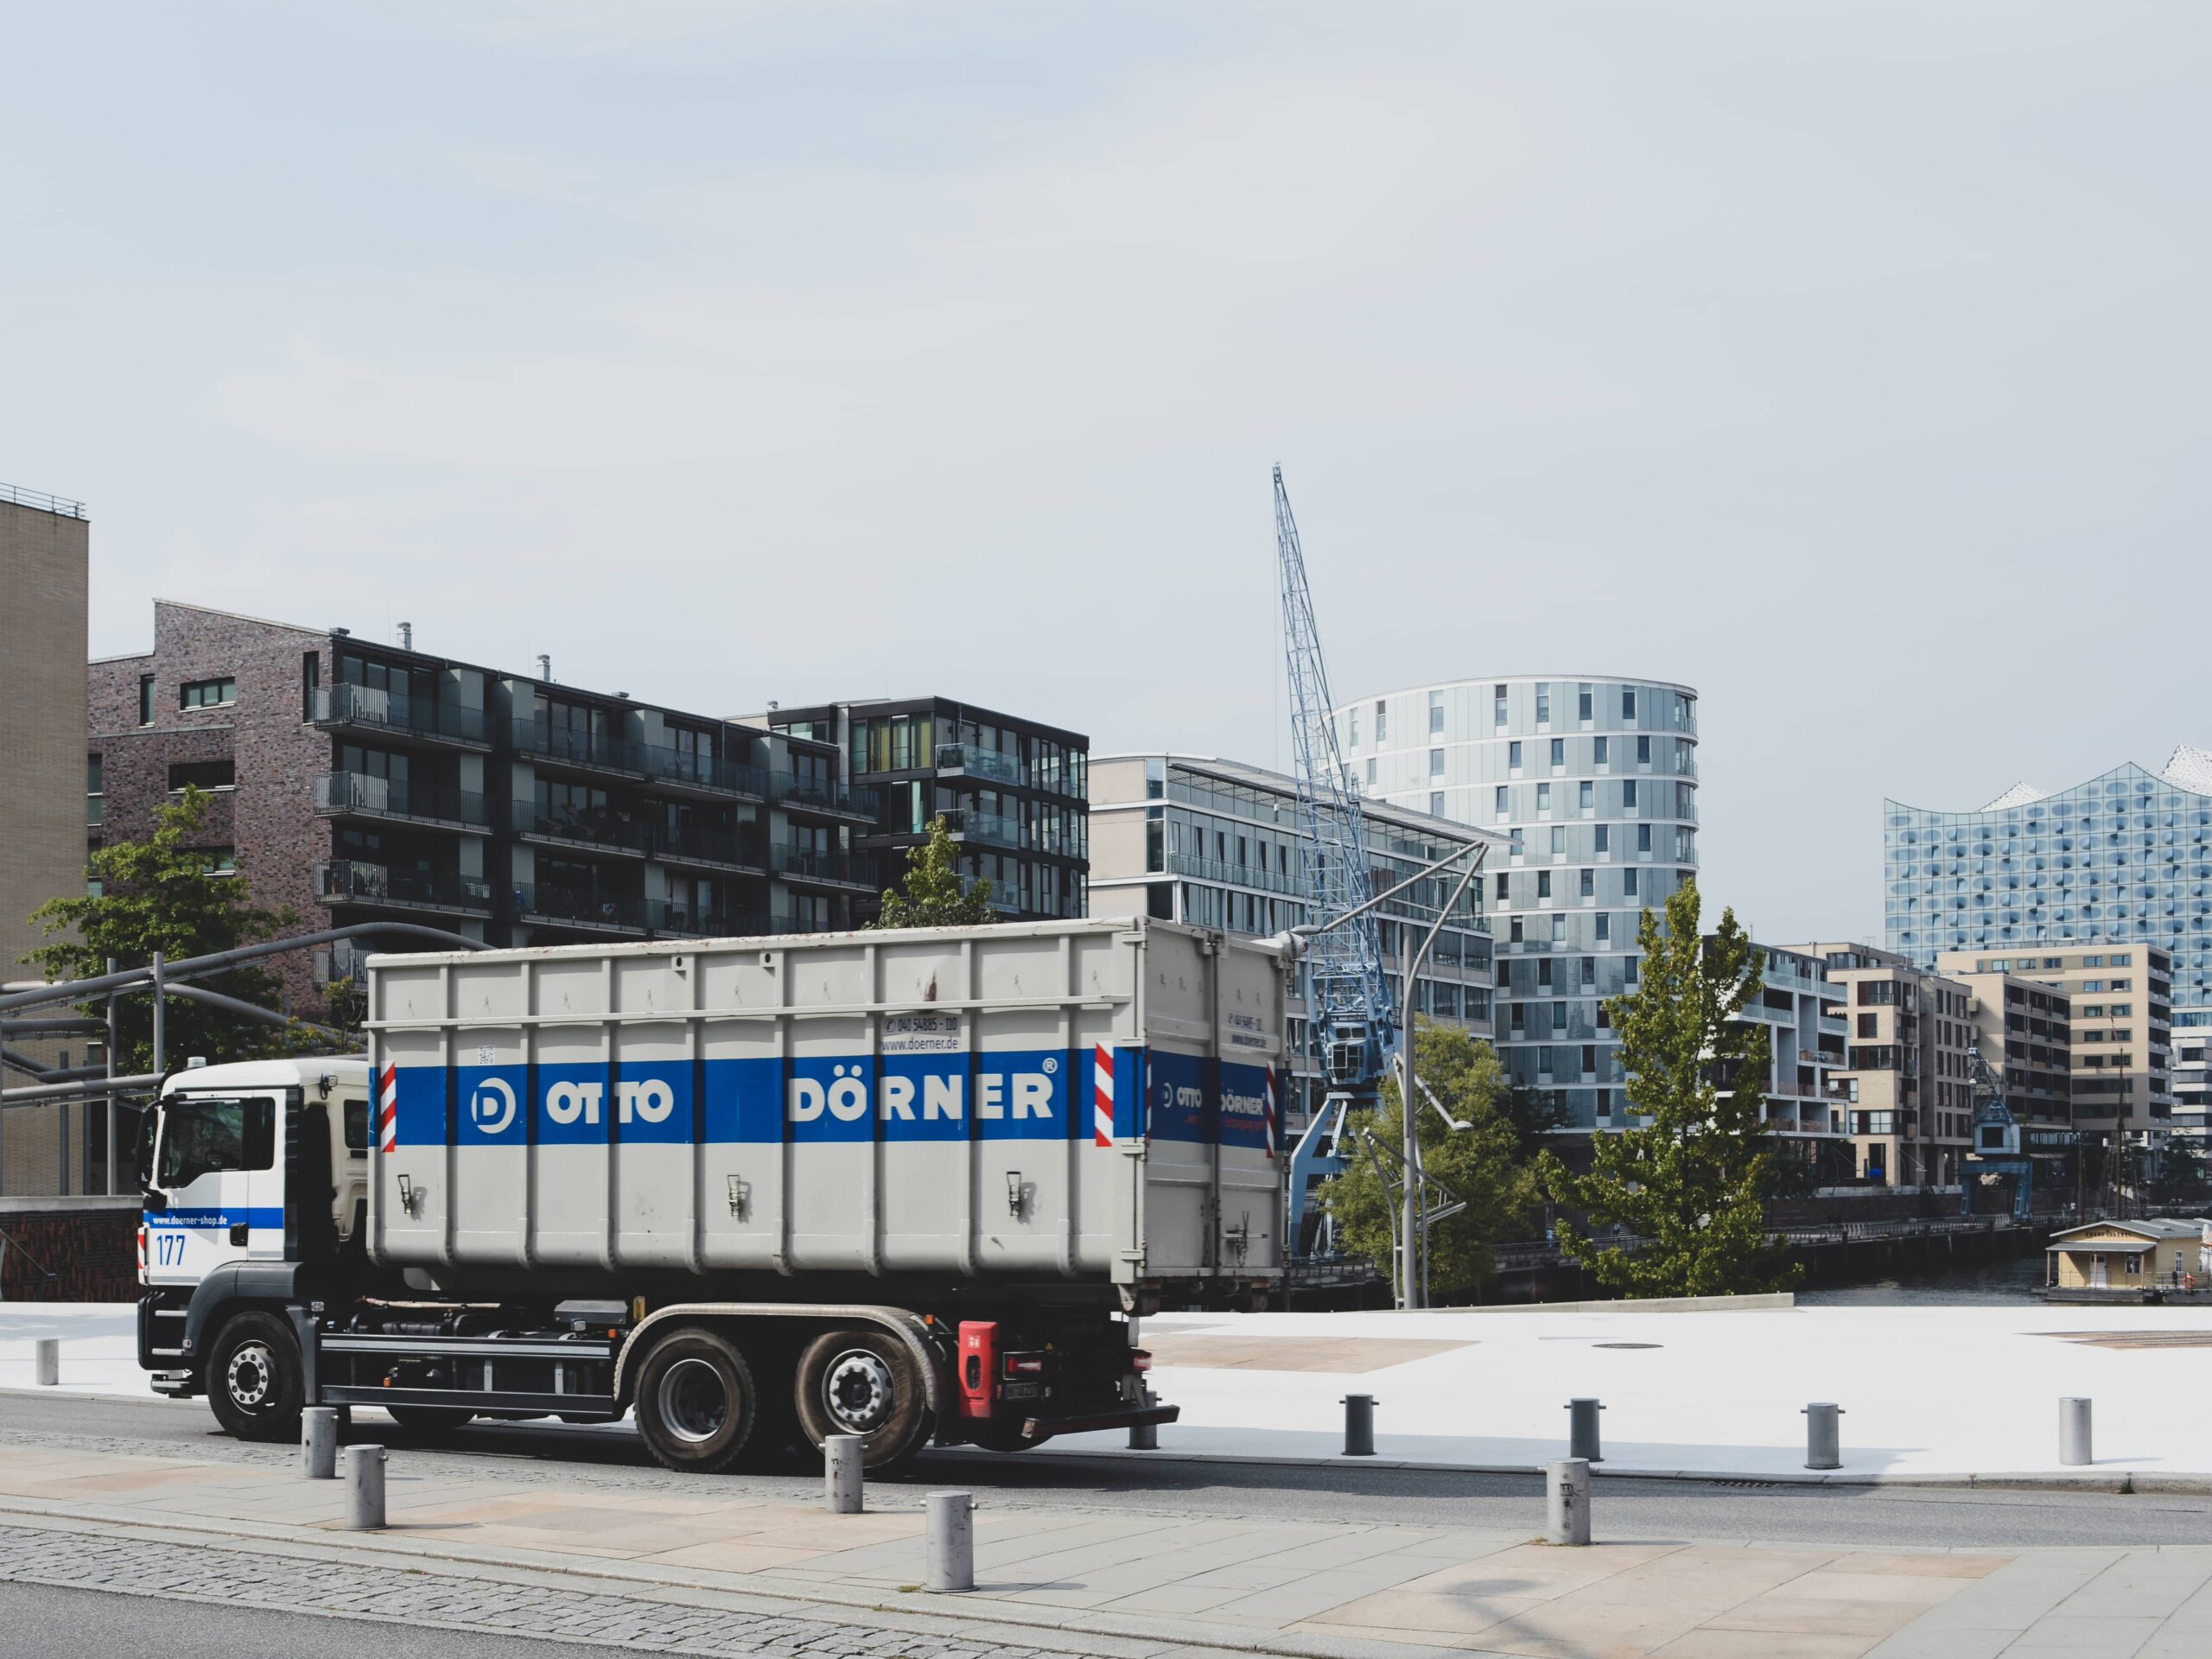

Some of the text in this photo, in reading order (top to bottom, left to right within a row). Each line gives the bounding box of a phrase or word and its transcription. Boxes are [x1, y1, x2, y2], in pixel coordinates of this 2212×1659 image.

[898, 1019, 912, 1032] 040
[882, 1036, 958, 1051] www.doerner.de
[546, 1079, 674, 1124] OTTO
[1177, 1086, 1203, 1108] OTTO
[152, 1215, 228, 1226] www.doerner-shop.de
[156, 1235, 186, 1266] 177
